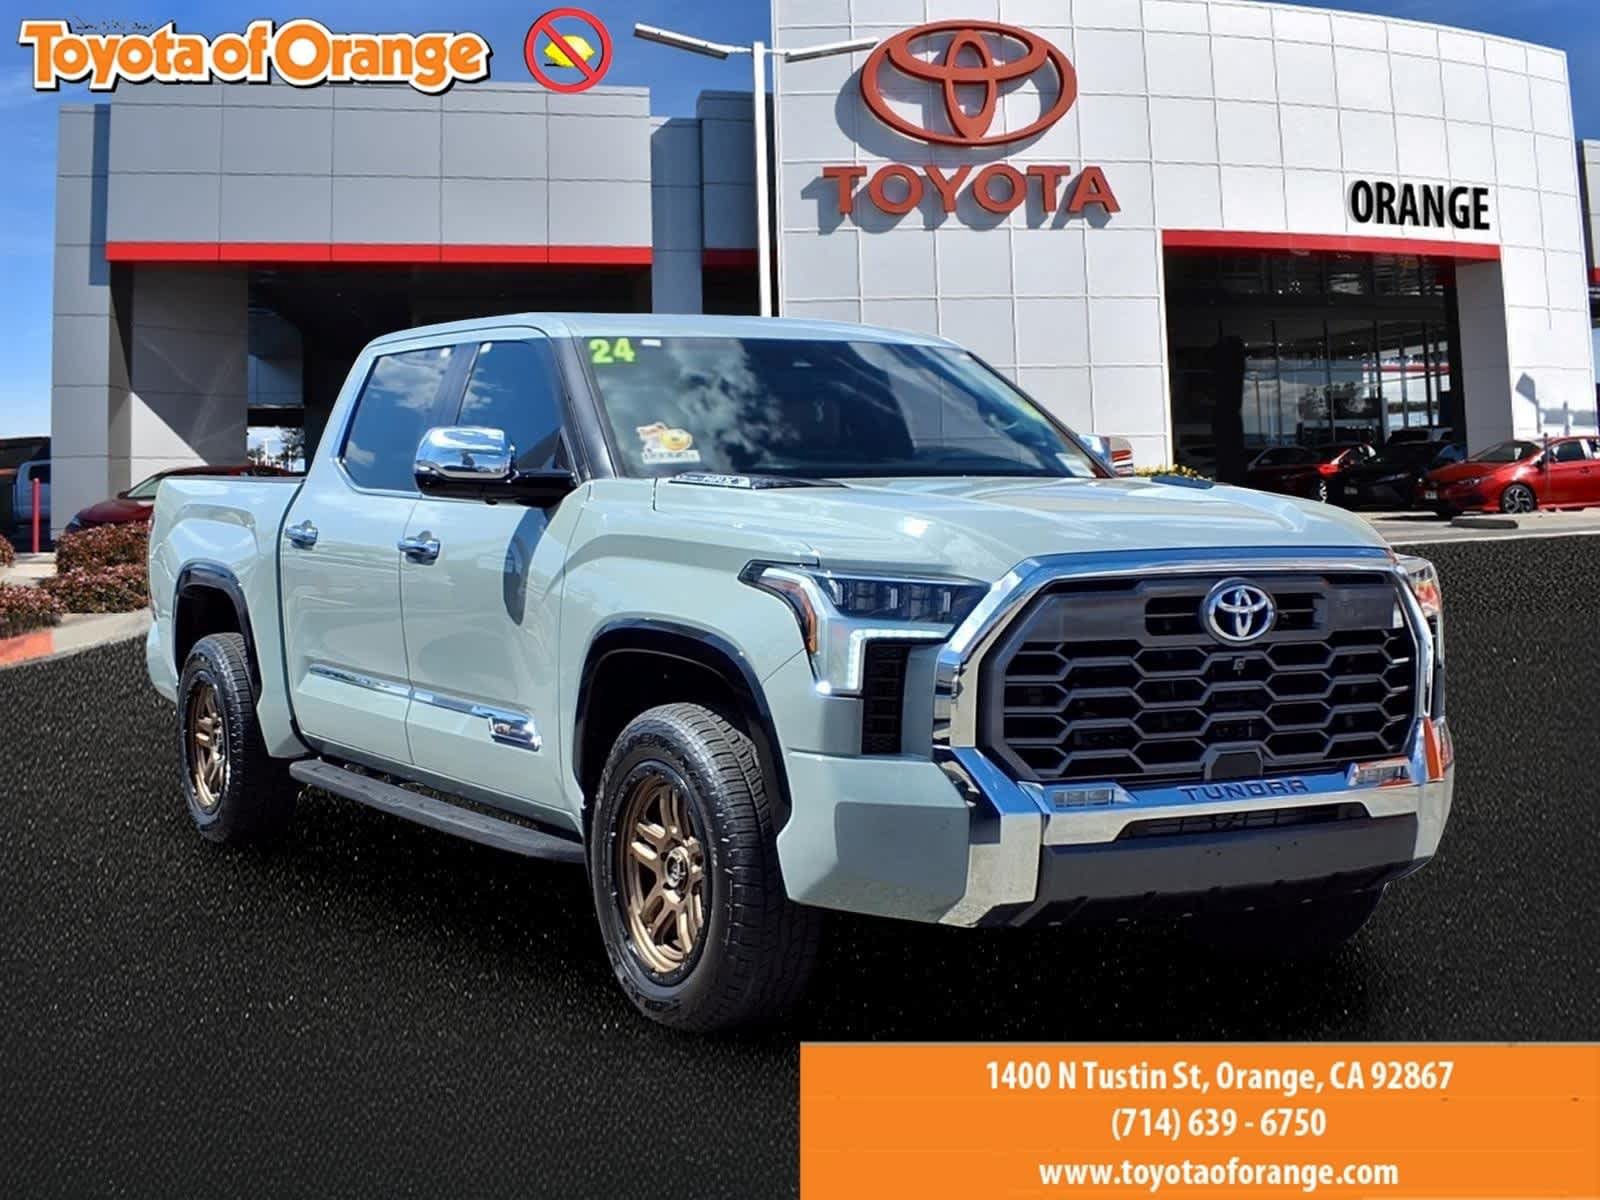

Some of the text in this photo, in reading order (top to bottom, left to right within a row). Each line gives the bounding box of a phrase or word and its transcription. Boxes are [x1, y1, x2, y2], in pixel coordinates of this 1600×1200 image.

[822, 163, 1121, 215] TOYOTA
[1350, 179, 1491, 231] ORANGE
[588, 337, 636, 364] 24
[1178, 778, 1309, 801] TUNDRA
